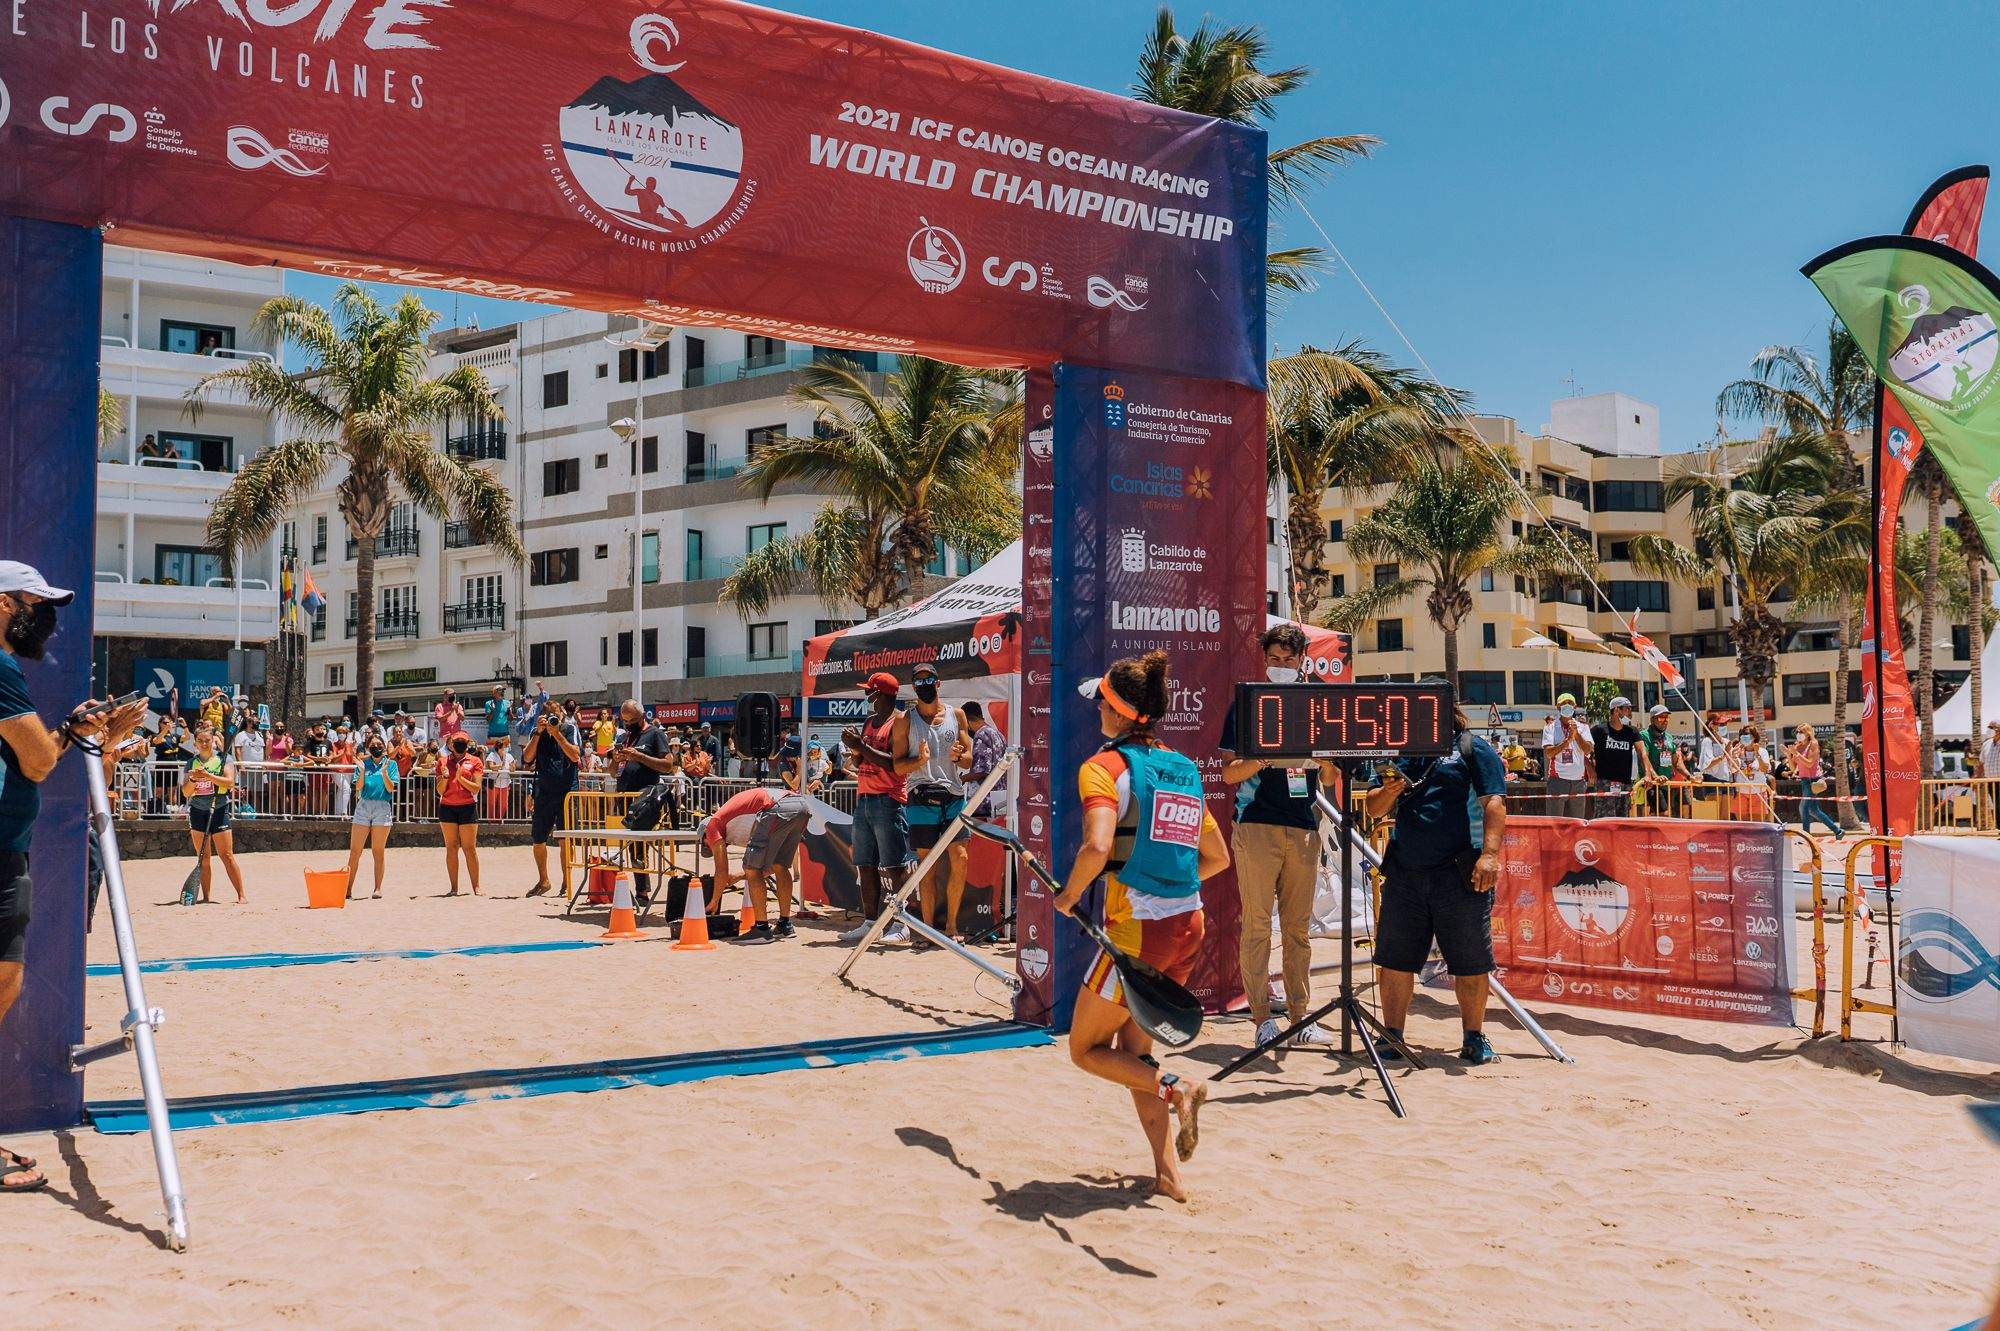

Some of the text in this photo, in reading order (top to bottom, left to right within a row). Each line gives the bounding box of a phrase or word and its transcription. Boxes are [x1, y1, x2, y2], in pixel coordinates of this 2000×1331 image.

[81, 10, 158, 60] LOS
[207, 35, 424, 109] VOLCANES
[146, 125, 181, 137] Consejo
[595, 116, 707, 151] LANZAROTE
[146, 133, 183, 145] Superior
[288, 132, 329, 148] canoe
[146, 141, 198, 156] de Deportes
[288, 142, 329, 155] federation
[656, 145, 694, 156] VOLCANES
[838, 101, 1210, 198] 2021 ICF CANOE OCEAN RACING
[634, 153, 670, 168] 2021
[809, 133, 1233, 242] WORLD CHAMPIONSHIP
[542, 143, 758, 254] ICF CANOE OCEAN RACING WORLD CHAMPIONSHIPS
[1042, 277, 1063, 286] Consejo
[1042, 283, 1064, 292] Superior
[1124, 278, 1149, 289] canoe
[726, 315, 791, 328] CANOE
[791, 324, 853, 337] OCEAN
[851, 332, 915, 346] RACING
[1127, 402, 1232, 425] Gobierno de Canarias
[1127, 418, 1212, 437] Consejería de Turismo,
[1127, 429, 1206, 445] Industria y Comercio
[1147, 461, 1184, 481] Islas
[1110, 474, 1184, 497] Canarias
[1149, 544, 1207, 559] Cabildo de
[1150, 558, 1203, 572] Lanzarote
[1112, 600, 1221, 633] Lanzarote
[1111, 639, 1221, 651] A UNIQUE ISLAND
[394, 668, 434, 681] FARMACIA
[808, 658, 844, 676] Clasificaciones
[701, 706, 734, 716] RE/MAX
[1158, 802, 1200, 828] 088
[1651, 914, 1687, 923] ARMAS
[1690, 952, 1719, 963] NEEDS
[1733, 958, 1777, 970] Lanzawagen
[1691, 987, 1714, 996] CANOE
[1714, 989, 1738, 998] OCEAN
[1738, 992, 1763, 1001] RACING
[1656, 994, 1772, 1013] WORLD CHAMPIONSHIP
